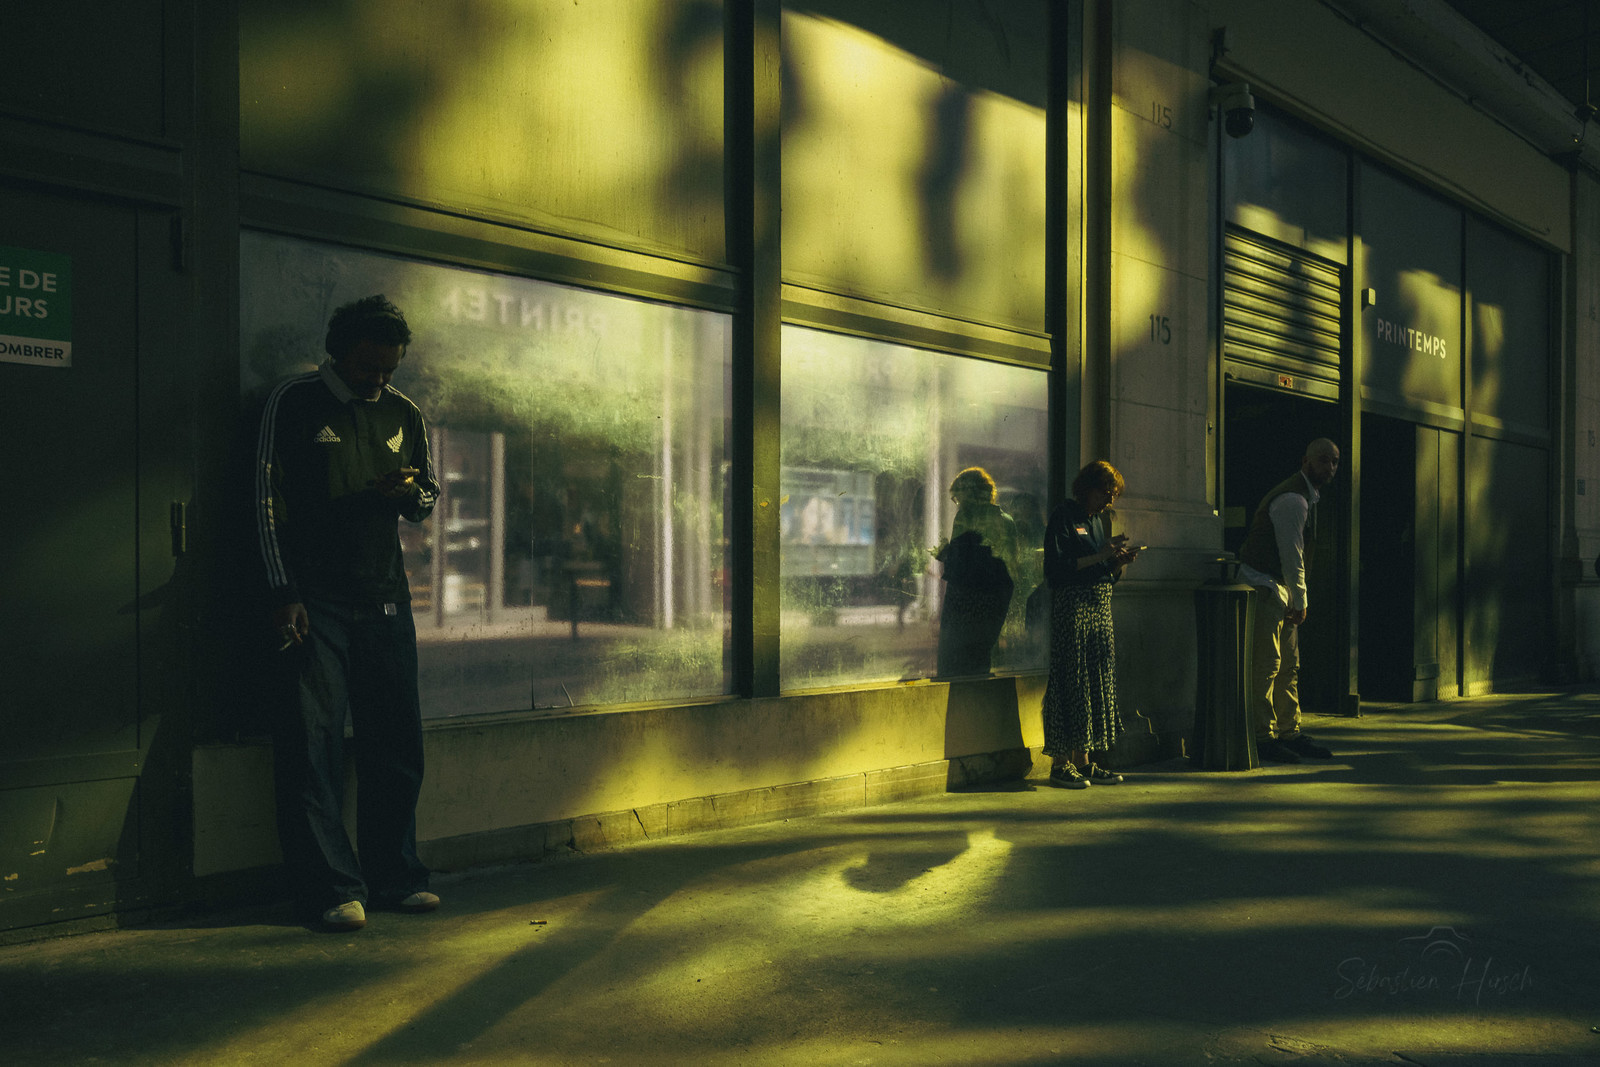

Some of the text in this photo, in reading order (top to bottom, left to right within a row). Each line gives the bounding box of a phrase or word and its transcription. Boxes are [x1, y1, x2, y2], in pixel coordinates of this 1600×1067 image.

[1152, 100, 1172, 129] 115
[19, 269, 57, 292] DE
[1149, 313, 1171, 345] 115
[1377, 317, 1447, 359] PRINTEMPS
[313, 435, 341, 443] adidas
